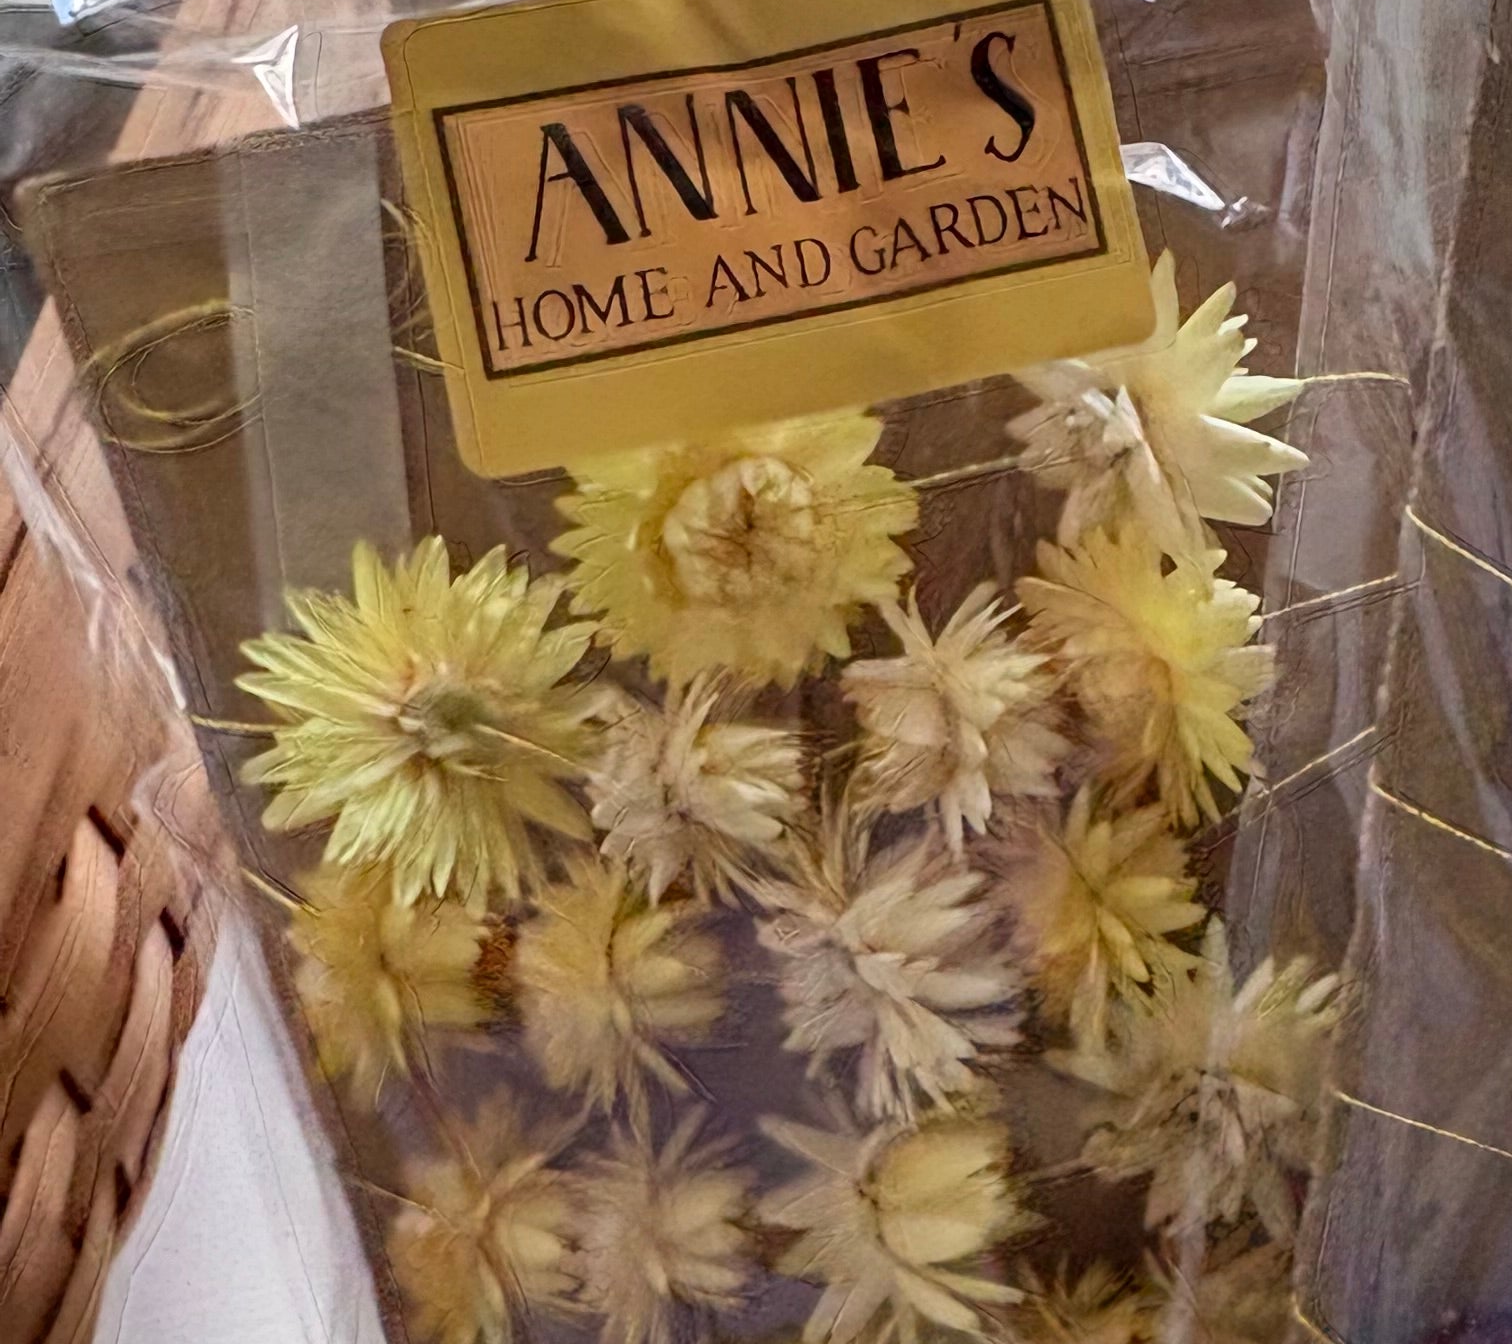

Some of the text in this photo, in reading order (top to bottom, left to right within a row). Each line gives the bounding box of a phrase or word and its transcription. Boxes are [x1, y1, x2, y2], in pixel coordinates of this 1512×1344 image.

[524, 22, 1036, 262] ANNIE'S
[491, 176, 1089, 351] HOME AND GARDEN
